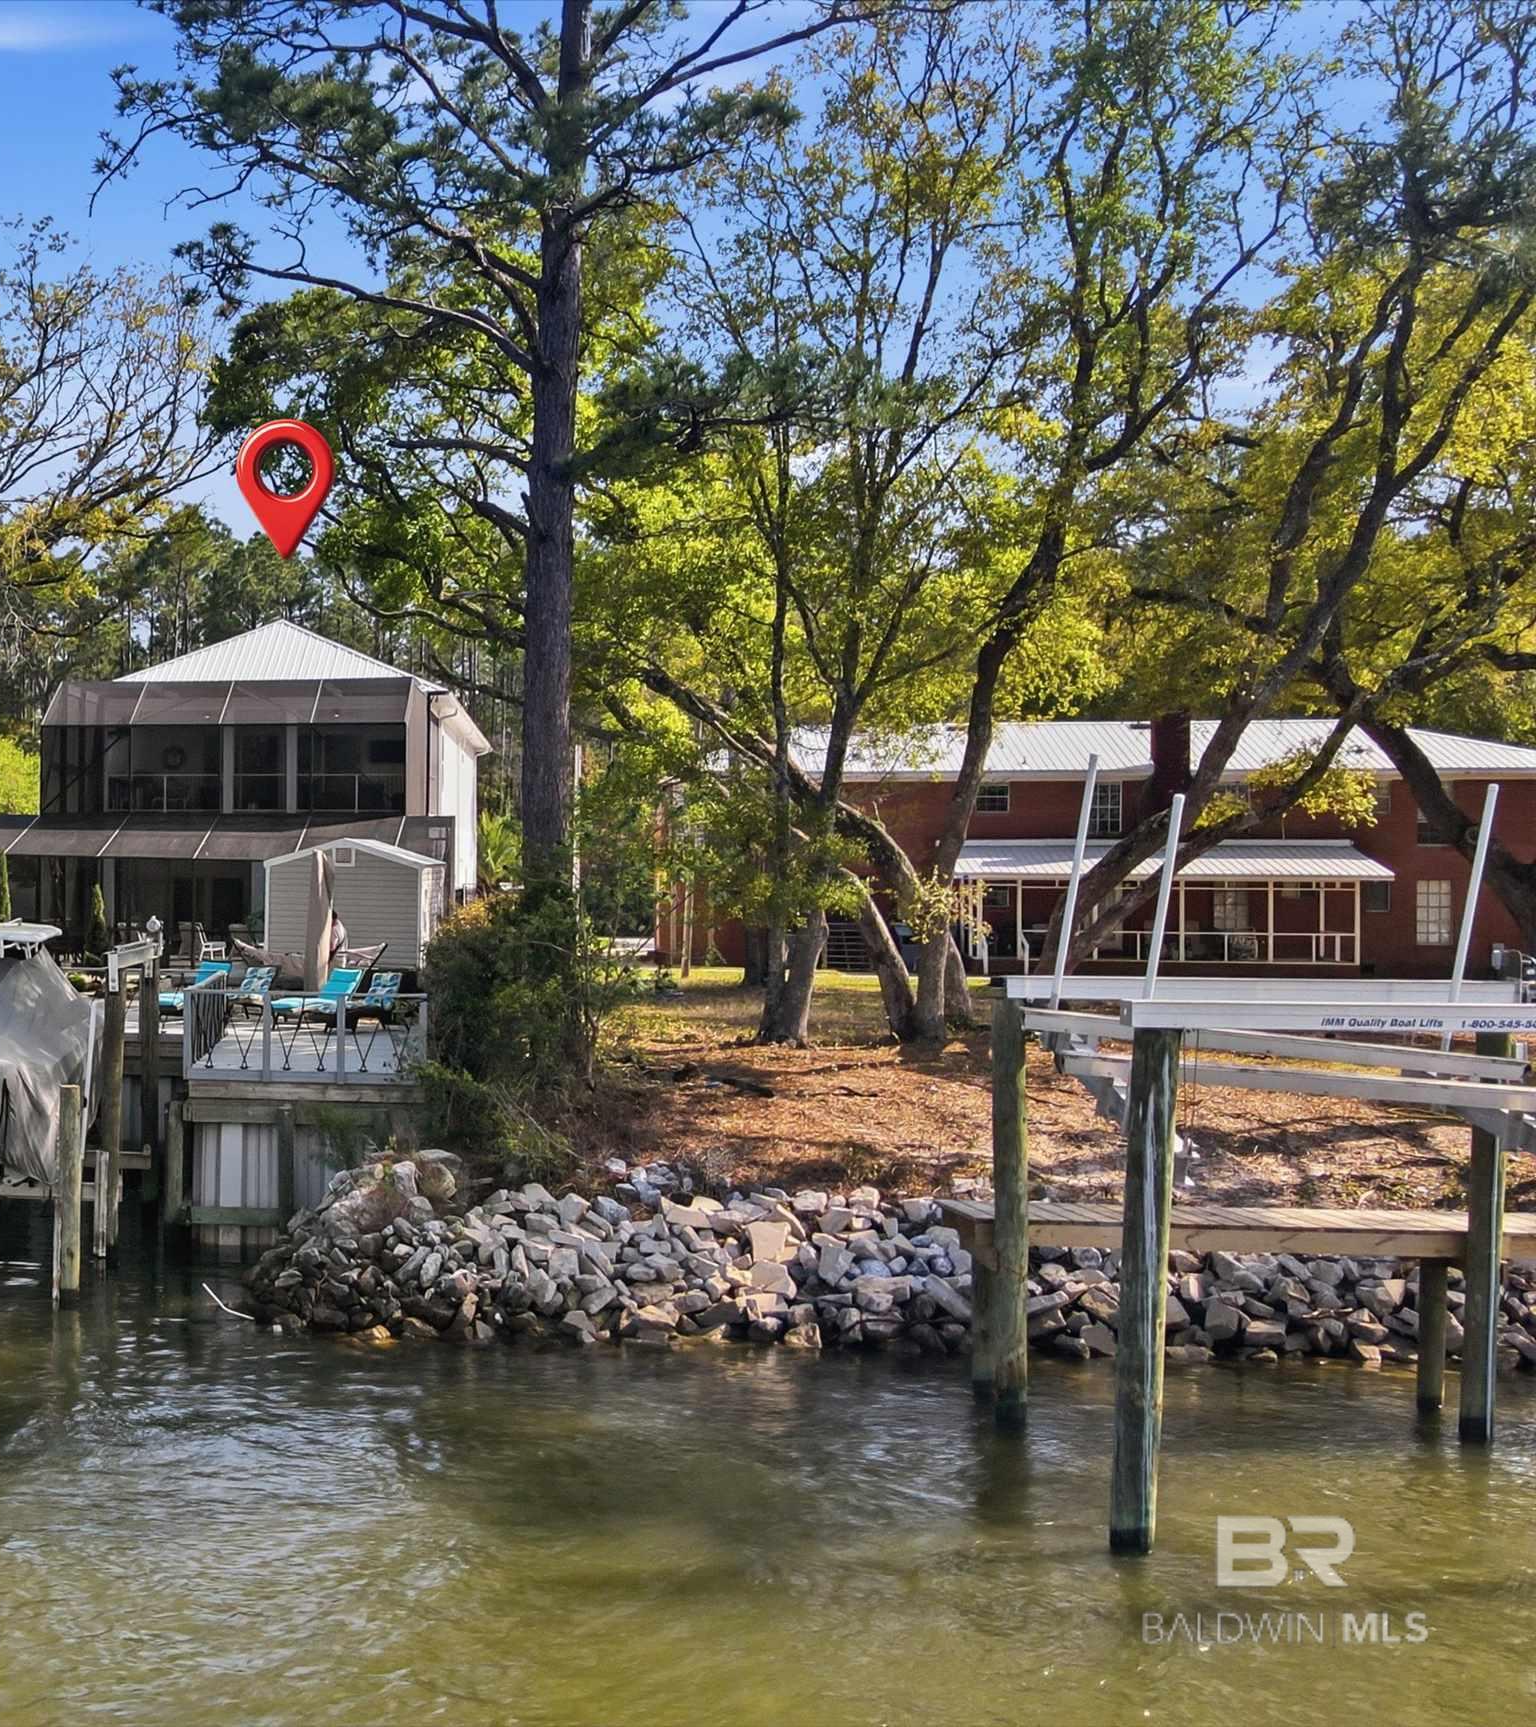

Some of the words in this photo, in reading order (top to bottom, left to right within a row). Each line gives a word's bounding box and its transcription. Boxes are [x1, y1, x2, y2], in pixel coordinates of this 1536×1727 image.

[1348, 1018, 1387, 1028] Quality
[1390, 1018, 1417, 1027] Boat
[1419, 1018, 1444, 1028] Lifts
